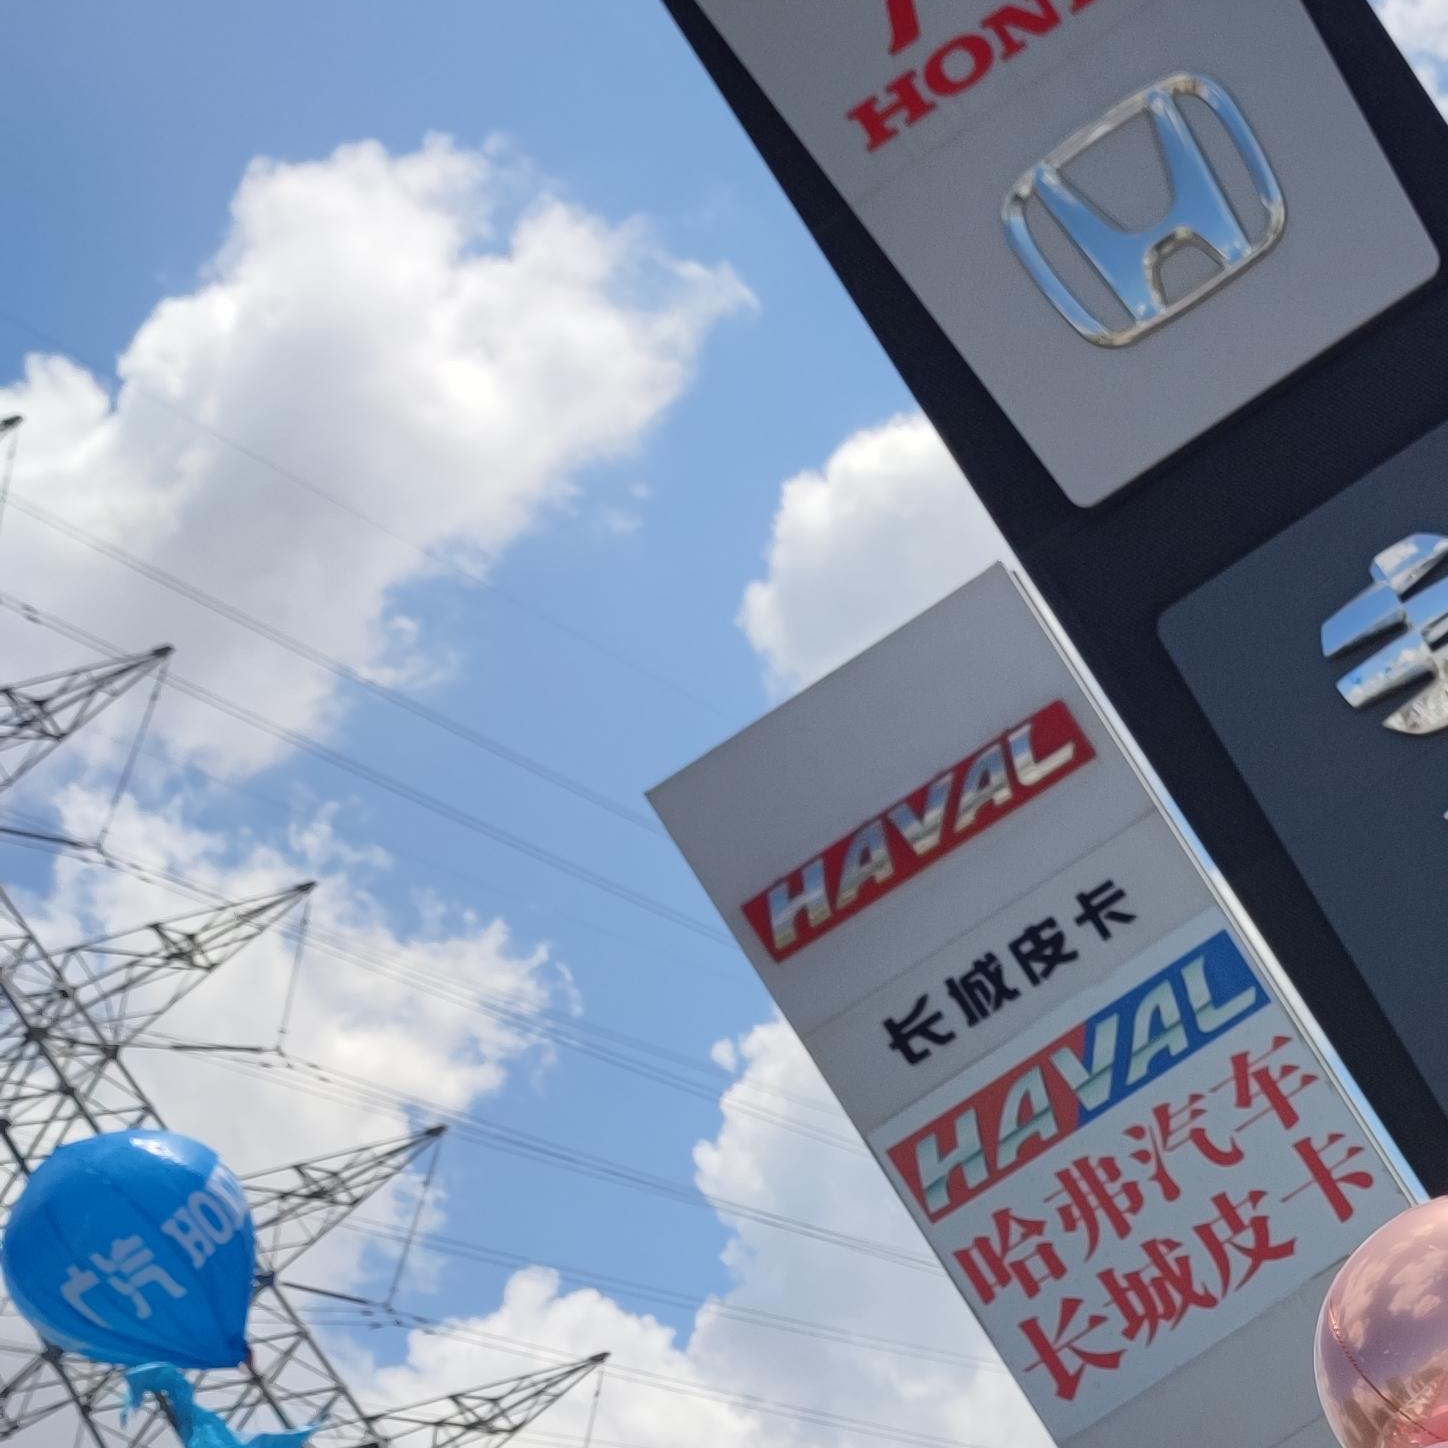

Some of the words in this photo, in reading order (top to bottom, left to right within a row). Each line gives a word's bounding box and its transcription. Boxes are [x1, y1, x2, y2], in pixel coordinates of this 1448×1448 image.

[765, 720, 1080, 954] HAVAL
[881, 878, 1138, 1067] 长城皮卡
[909, 945, 1264, 1214] HAVAL
[951, 1035, 1320, 1306] 哈弗汽车
[1017, 1132, 1376, 1402] 长城皮卡
